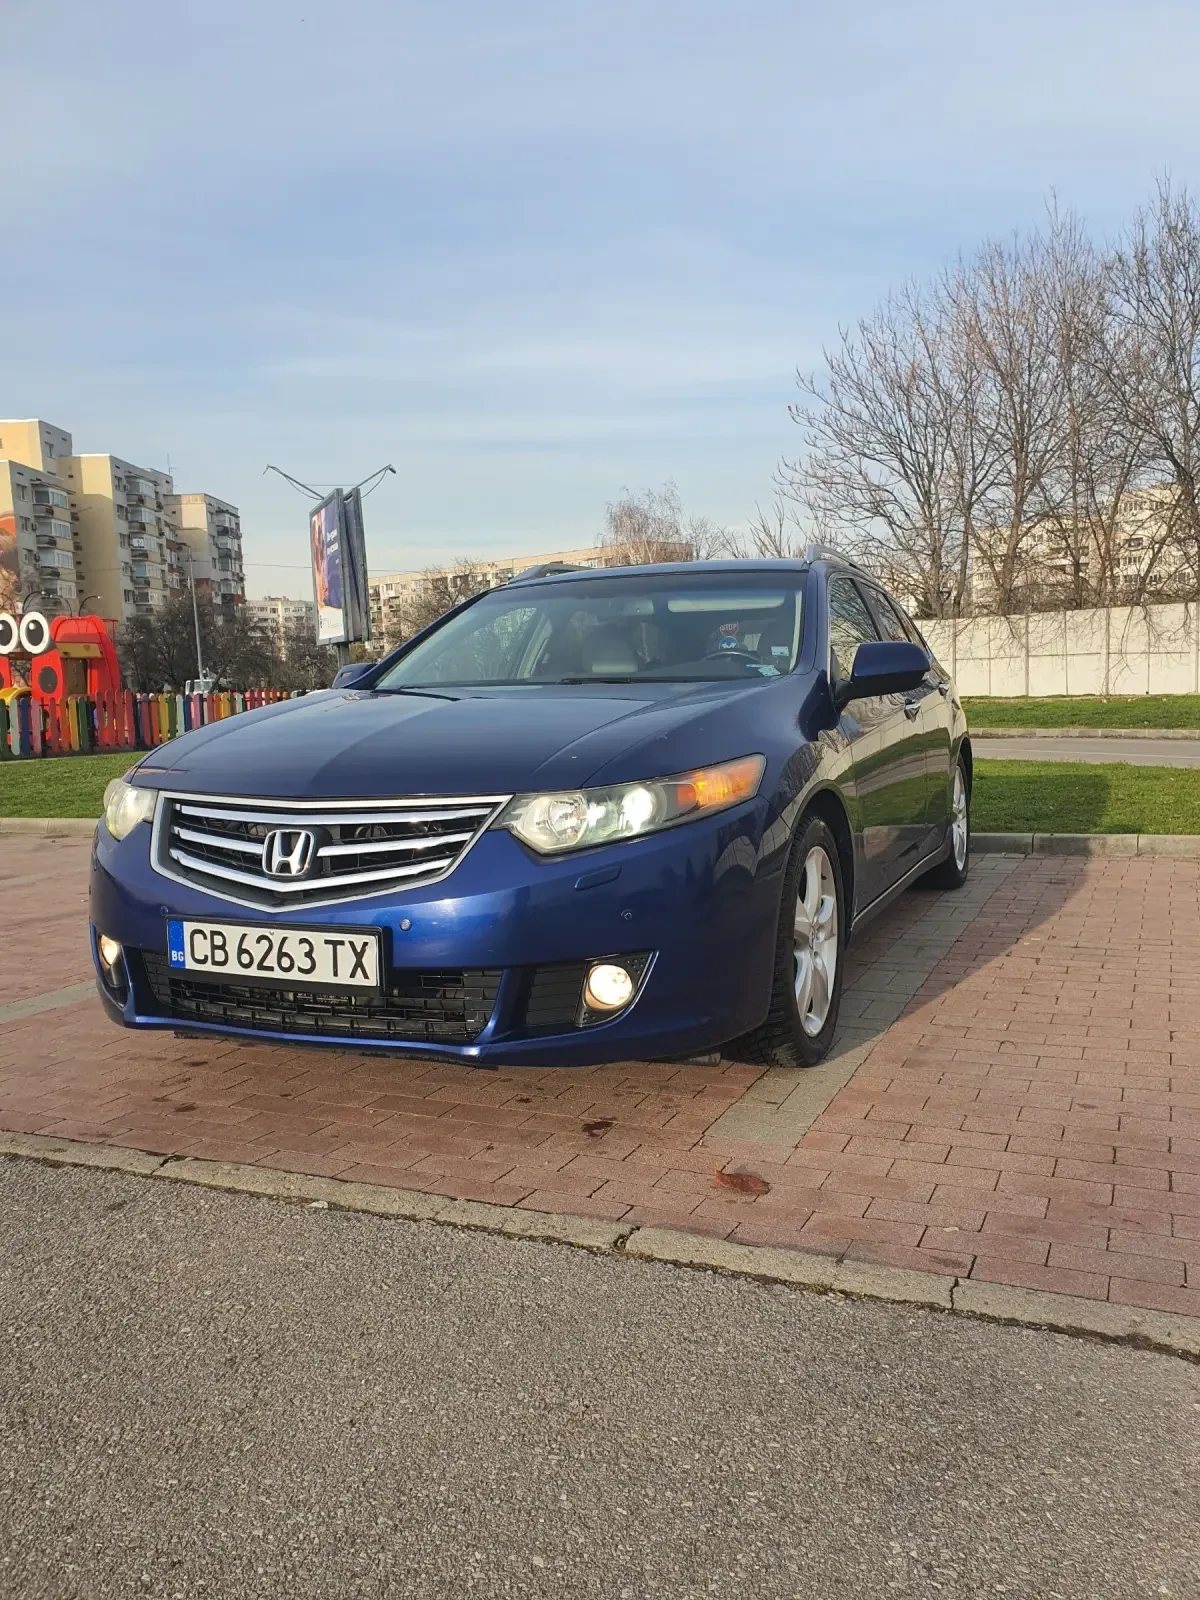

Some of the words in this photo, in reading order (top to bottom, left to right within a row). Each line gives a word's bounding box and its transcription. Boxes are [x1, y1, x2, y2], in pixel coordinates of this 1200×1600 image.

[171, 950, 184, 962] BG
[189, 928, 229, 967] CB
[236, 932, 317, 975] 6263
[323, 939, 371, 980] TX
